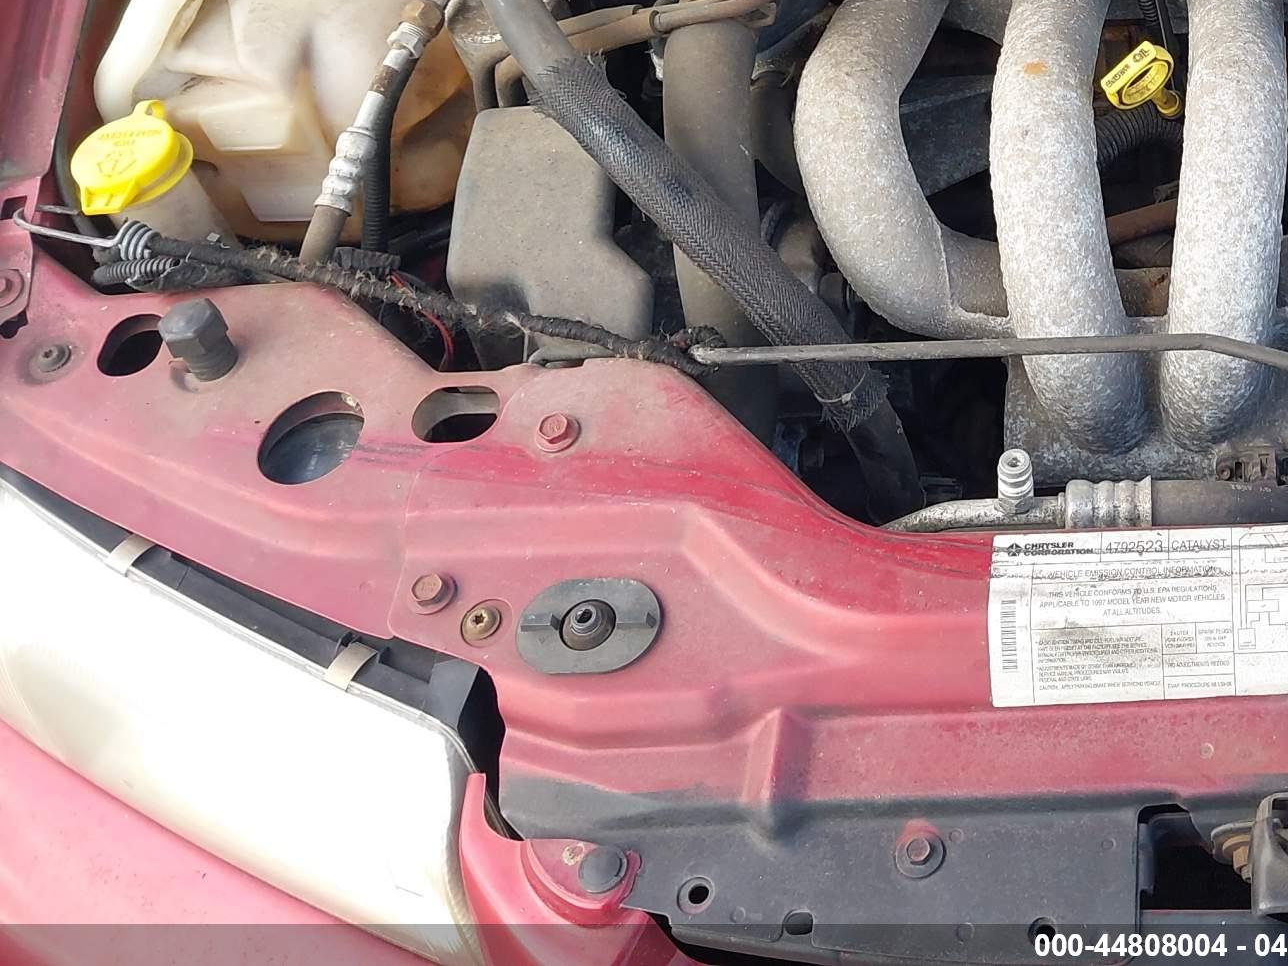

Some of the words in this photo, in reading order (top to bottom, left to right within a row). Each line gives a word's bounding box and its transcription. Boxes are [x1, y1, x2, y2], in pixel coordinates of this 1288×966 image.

[1024, 541, 1074, 551] CHRYSLER
[1105, 540, 1163, 553] 4792523
[1171, 538, 1228, 551] CATALYST
[1023, 547, 1094, 556] CORPORATION
[1124, 566, 1161, 576] CONTROL
[1193, 593, 1226, 601] VEHICLES
